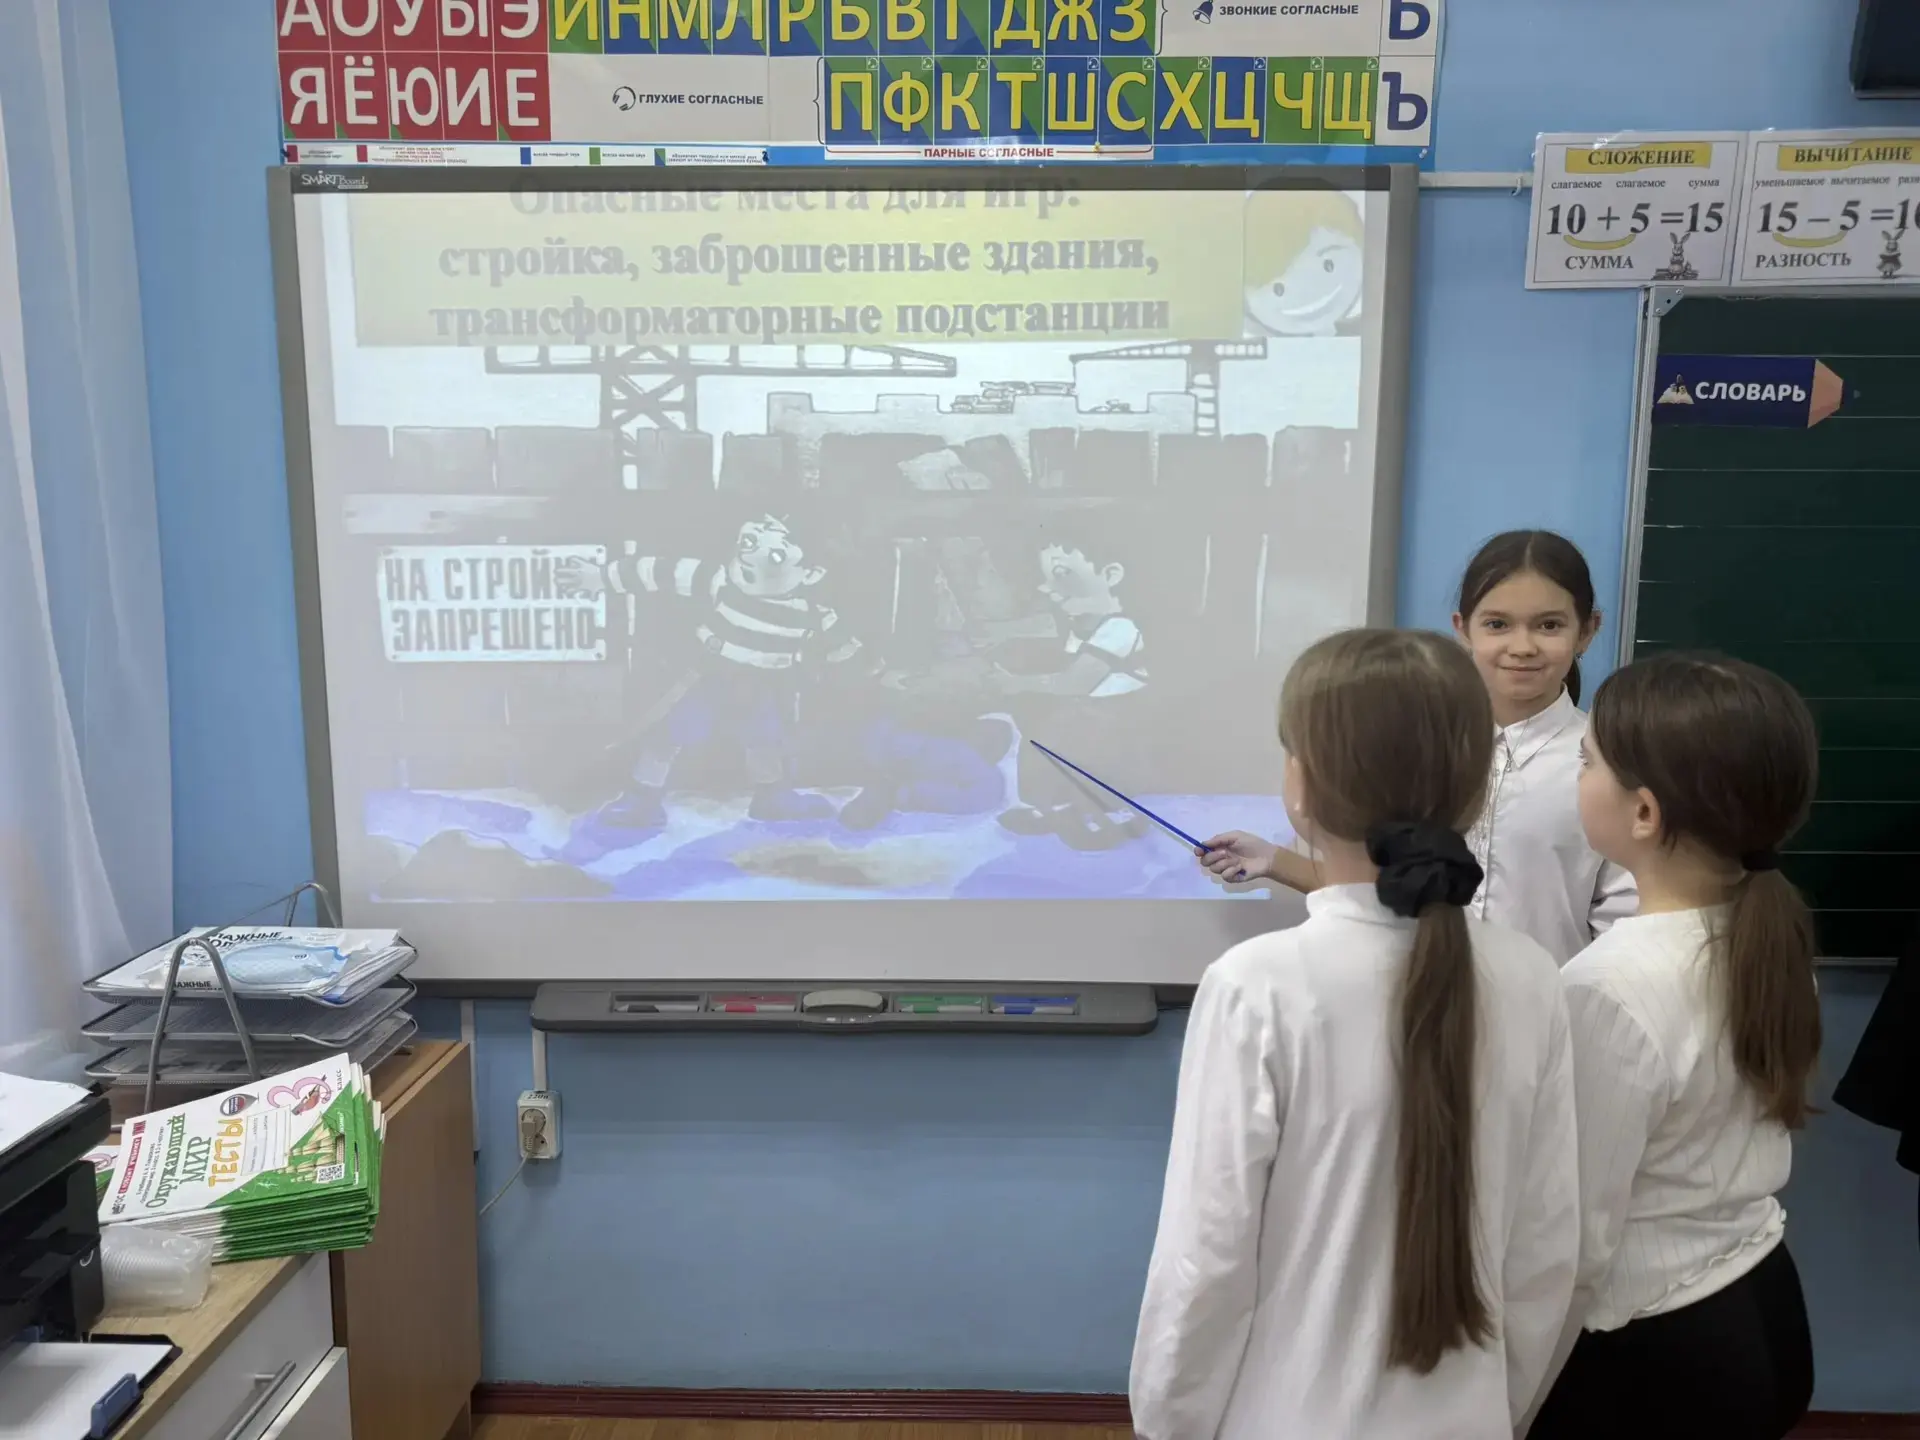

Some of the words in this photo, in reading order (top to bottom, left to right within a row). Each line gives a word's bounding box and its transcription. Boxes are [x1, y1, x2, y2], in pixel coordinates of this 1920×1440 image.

[1219, 5, 1277, 16] ЗВОНКИЕ
[1280, 4, 1359, 16] СОГЛАСНЫЕ
[289, 67, 328, 125] Я
[343, 55, 378, 125] Ё
[388, 67, 440, 126] Ю
[446, 67, 491, 126] И
[639, 94, 685, 104] ГЛУХИЕ
[688, 94, 764, 105] СОГЛАСНЫЕ
[830, 72, 872, 131] П
[883, 71, 930, 132] Ф
[941, 72, 981, 131] К
[996, 72, 1037, 130] Т
[1048, 72, 1096, 130] Ш
[1106, 71, 1147, 131] С
[1159, 71, 1204, 130] Х
[1215, 71, 1260, 138] Ц
[1274, 71, 1314, 130] Ч
[1323, 71, 1371, 139] Щ
[924, 147, 976, 158] ПАРНЫЕ
[979, 147, 1054, 158] СОГЛАСНЫЕ
[1587, 149, 1696, 166] СЛОЖЕНИЕ
[1793, 146, 1913, 164] ВЫЧИТАНИЕ
[1551, 180, 1602, 190] слагаемое
[1616, 179, 1666, 188] слагаемое
[1688, 180, 1720, 190] сумма
[1754, 176, 1826, 189] уменьшаемое
[1831, 176, 1891, 186] вычитаемое
[1546, 203, 1587, 235] 10
[1630, 202, 1652, 234] 5
[1757, 201, 1799, 233] 15
[1839, 200, 1861, 231] 5
[438, 236, 639, 288] стройка,
[651, 232, 970, 287] заброшенные
[983, 237, 1159, 276] здания,
[1564, 255, 1634, 270] СУММА
[1755, 252, 1852, 268] РАЗНОСТЬ
[428, 295, 883, 347] трансформаторные
[895, 300, 1170, 339] подстанции
[1694, 380, 1807, 403] СЛОВАРЬ
[384, 557, 429, 602] НА
[217, 931, 283, 942] ЛАЖНЫЕ
[145, 1112, 187, 1208] Окружающий
[179, 1136, 212, 1185] МИР
[208, 1117, 243, 1188] ТЕСТЫ
